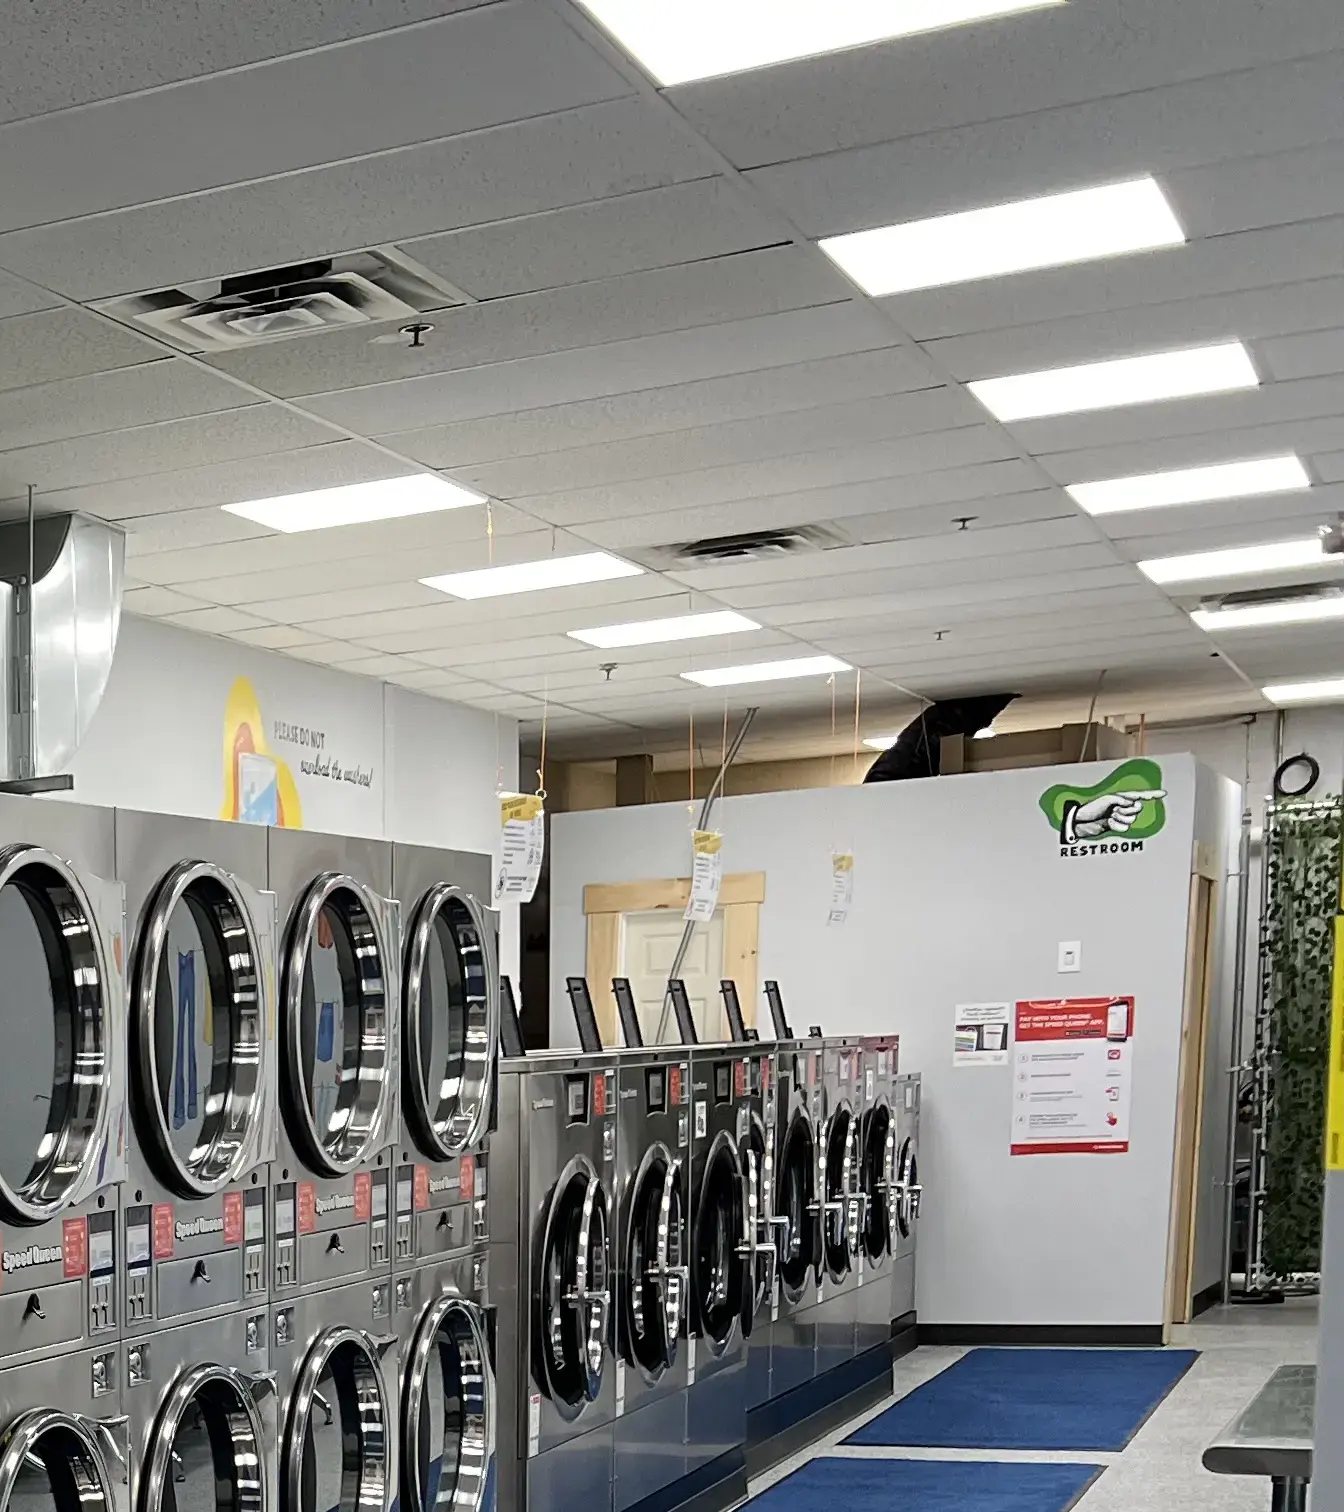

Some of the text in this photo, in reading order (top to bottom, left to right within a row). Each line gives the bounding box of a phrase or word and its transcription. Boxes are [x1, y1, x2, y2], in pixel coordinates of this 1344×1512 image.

[273, 720, 325, 750] PLEASE DO NOT
[1060, 841, 1144, 857] RESTROOM
[2, 1244, 63, 1274] Speed Queen
